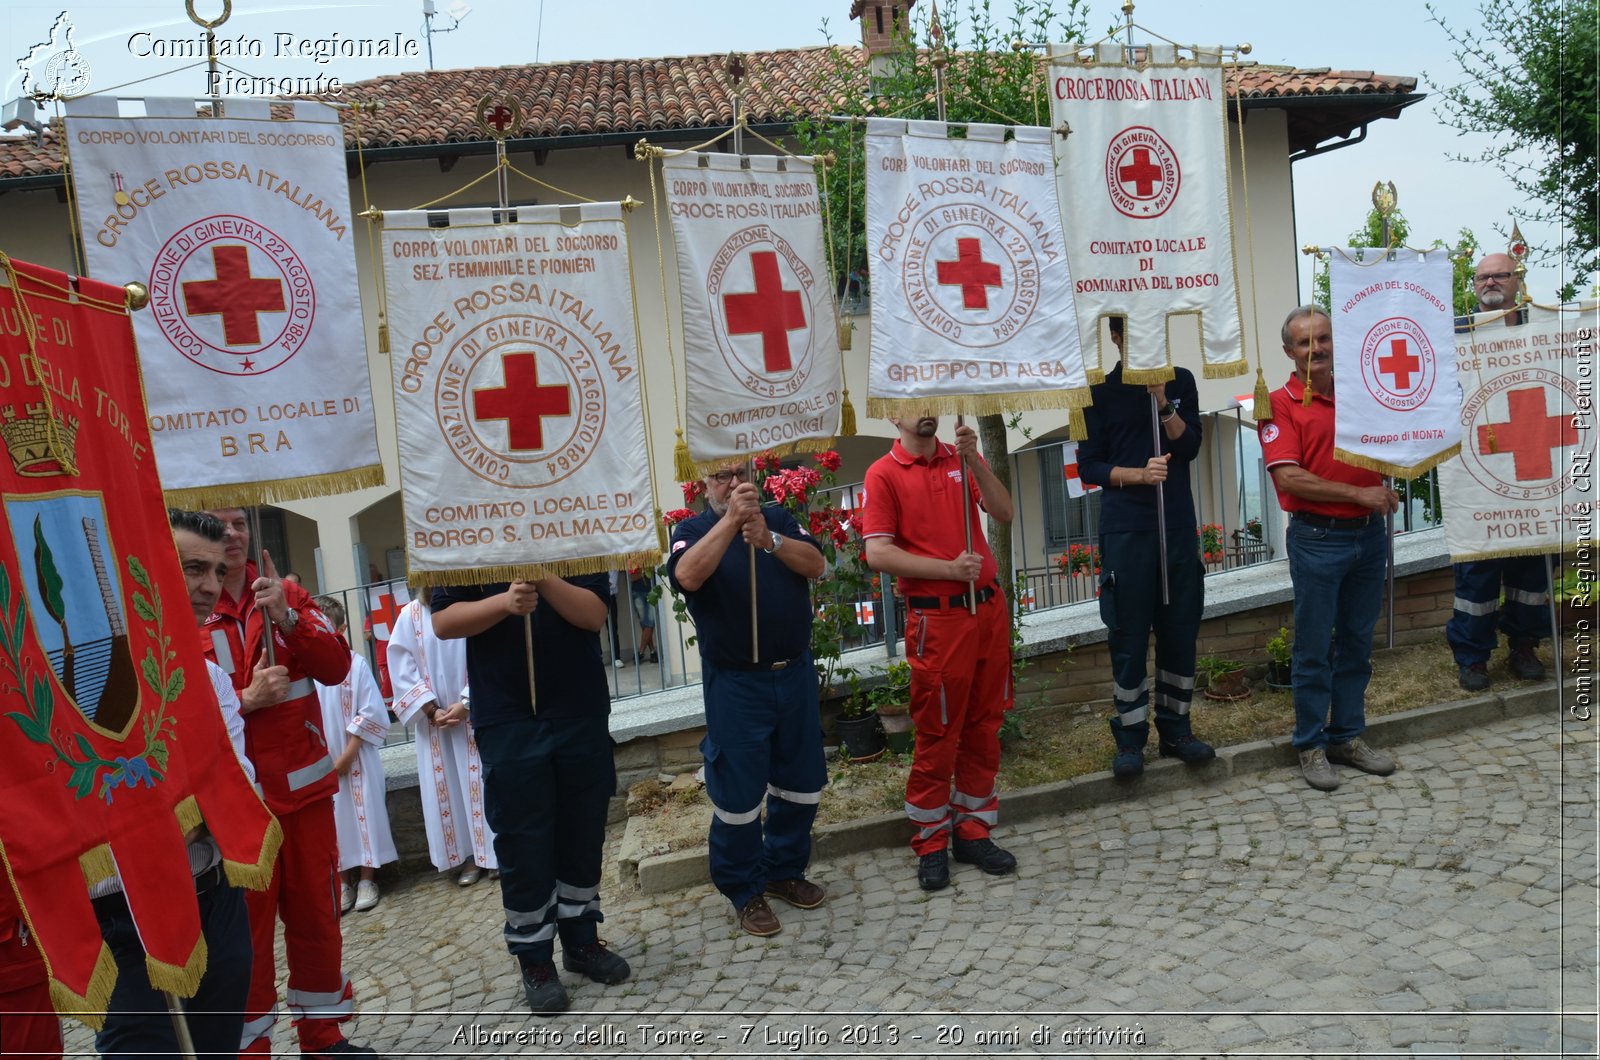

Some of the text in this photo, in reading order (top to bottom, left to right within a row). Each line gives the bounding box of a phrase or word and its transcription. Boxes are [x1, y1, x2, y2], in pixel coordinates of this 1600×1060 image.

[78, 130, 336, 147] CORPO VOLONTARI DEL SOCCORSO
[912, 154, 970, 172] VOLONTARI
[976, 160, 996, 175] DEL
[999, 158, 1045, 176] SOCCORSO
[1113, 143, 1123, 155] DI
[1122, 133, 1157, 147] GINEVRA
[1163, 157, 1175, 194] AGOSTO
[673, 180, 707, 196] CORPO
[96, 161, 347, 248] CROCE ROSSA ITALIANA
[671, 201, 724, 219] CROCE
[879, 177, 1060, 263] CROCE ROSSA ITALIANA
[444, 236, 518, 257] VOLONTARI
[524, 236, 550, 253] DEL
[556, 234, 618, 252] SOCCORSO
[1089, 237, 1207, 255] COMITATO LOCALE
[413, 257, 596, 281] SEZ. FEMMINILE E PIONIERI
[708, 228, 815, 296] CONVENZIONE GINEVRA
[907, 207, 1036, 340] CONVENZIONE DI GINEVRA 22 AGOSTO 1864
[1139, 257, 1154, 272] DI
[153, 220, 311, 357] CONVENZIONE DI GINEVRA 22 AGOSTO 1864
[1076, 273, 1219, 294] SOMMARIVA DEL BOSCO
[1341, 280, 1446, 315] VOLONTARI DEL SOCCORSO
[52, 317, 74, 348] DI
[401, 282, 633, 394] CROCE ROSSA ITALIANA
[1363, 321, 1432, 367] CONVENZIONE DI GINEVRA
[1470, 338, 1527, 355] VOLONTARI
[1532, 334, 1551, 347] DEL
[887, 360, 1068, 382] GRUPPO DI ALBA
[1487, 351, 1543, 369] ROSSA
[441, 320, 601, 480] CONVENZIONE DI GINEVRA 22 AGOSTO 1864
[706, 391, 839, 428] COMITATO LOCALE DI
[1375, 388, 1385, 398] 22
[1384, 396, 1415, 407] AGOSTO
[1461, 371, 1529, 427] CONVENZIONE
[1536, 371, 1548, 380] DI
[149, 397, 360, 432] OMITATO LOCALE DI
[1360, 434, 1399, 445] Gruppo
[1401, 431, 1411, 441] di
[425, 493, 633, 524] COMITATO LOCALE DI
[1473, 508, 1540, 521] COMITATO
[414, 513, 647, 549] BORGO S. DALMAZZO
